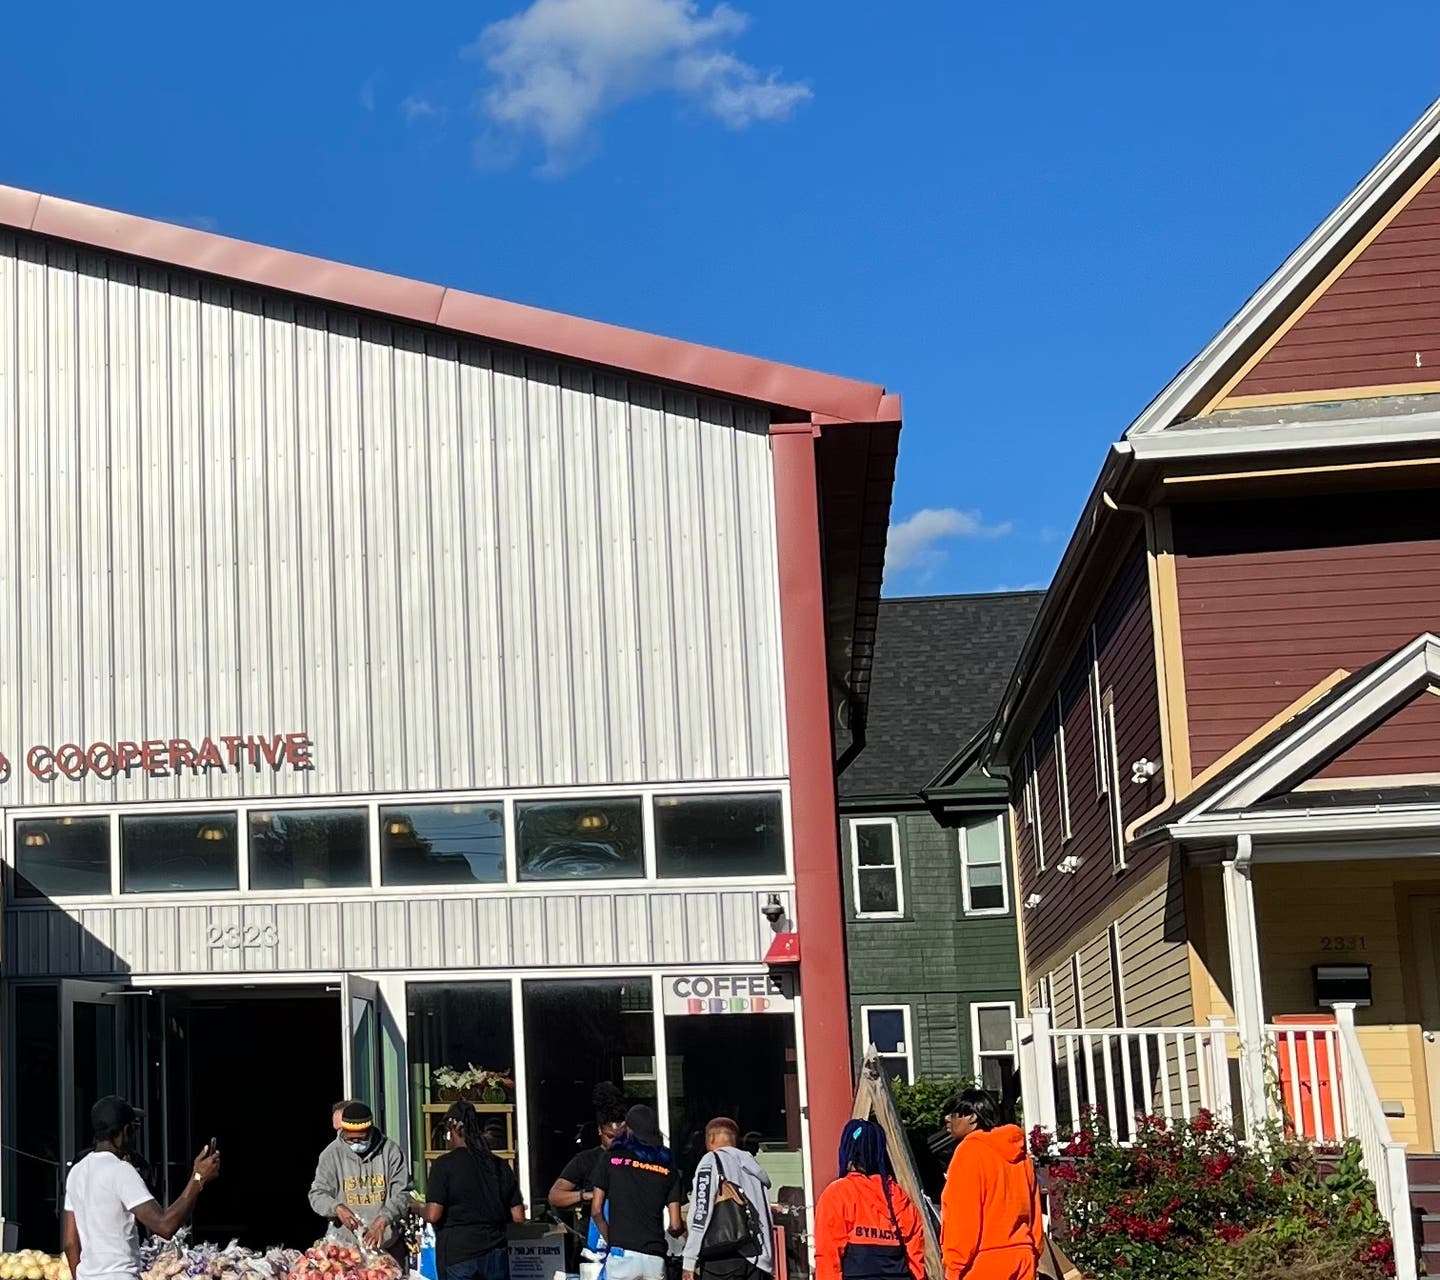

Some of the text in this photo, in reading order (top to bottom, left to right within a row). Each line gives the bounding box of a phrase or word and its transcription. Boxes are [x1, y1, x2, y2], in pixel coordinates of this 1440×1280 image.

[26, 733, 311, 779] COOPERATIVE
[207, 923, 279, 949] 2323
[672, 976, 784, 998] COFFEE
[695, 1175, 711, 1220] Tootsie
